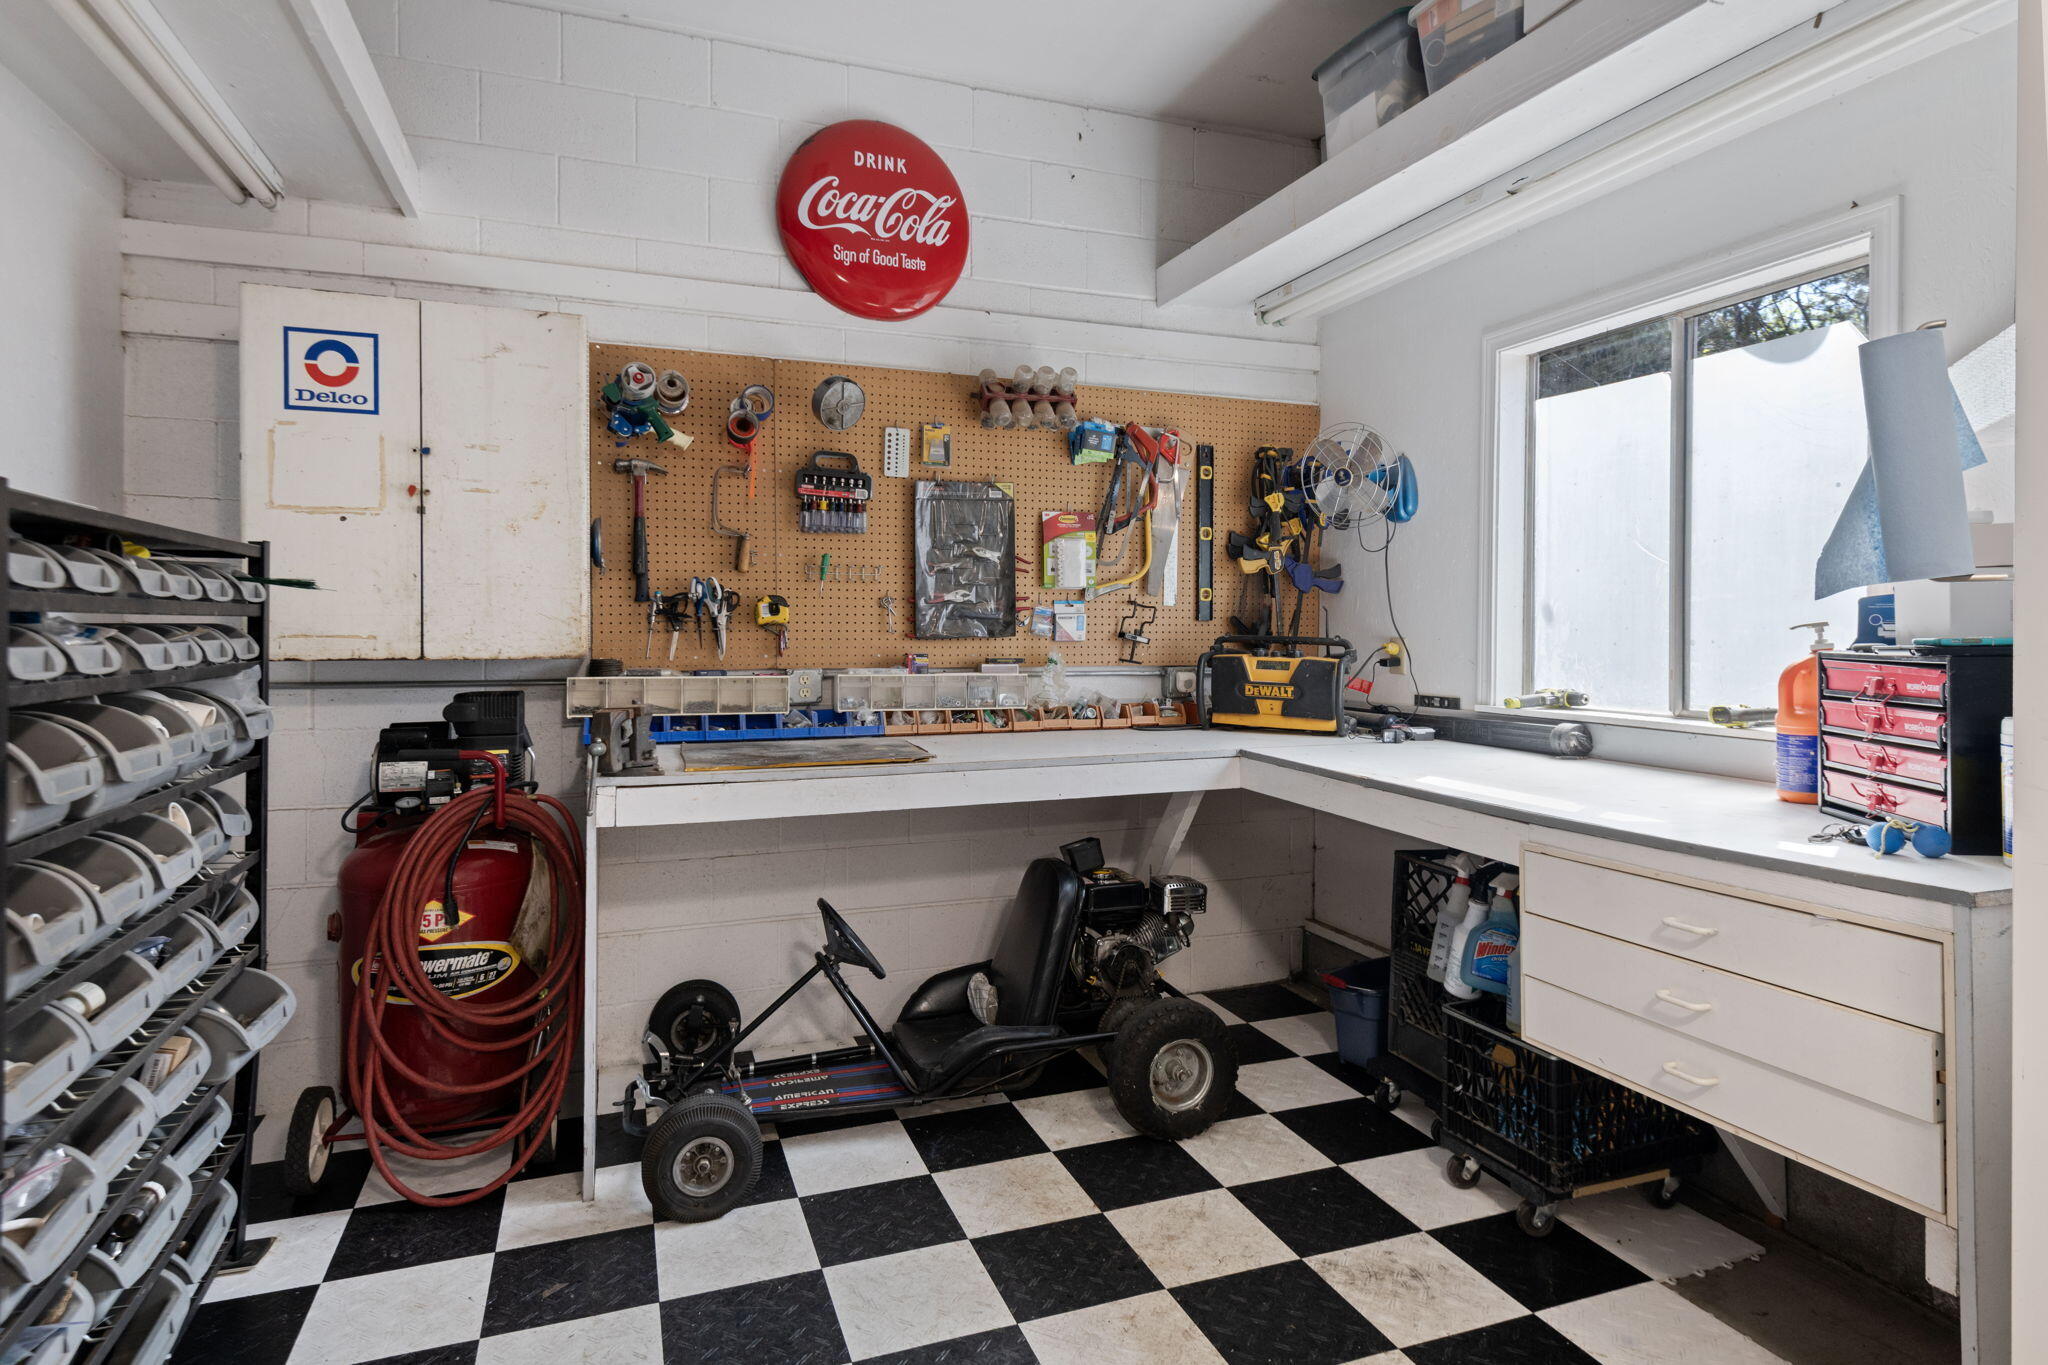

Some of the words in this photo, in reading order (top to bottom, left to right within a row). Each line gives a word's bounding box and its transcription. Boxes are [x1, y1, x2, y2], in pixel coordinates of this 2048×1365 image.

[854, 150, 907, 174] DRINK
[797, 175, 957, 247] Coca-Cola
[833, 244, 857, 266] Sign
[859, 248, 869, 263] of
[872, 249, 899, 267] Good
[900, 253, 926, 271] Taste
[295, 388, 368, 405] Delco
[420, 951, 491, 974] wermate
[774, 1088, 835, 1101] AMERICAN
[781, 1099, 830, 1110] EXPRESS
